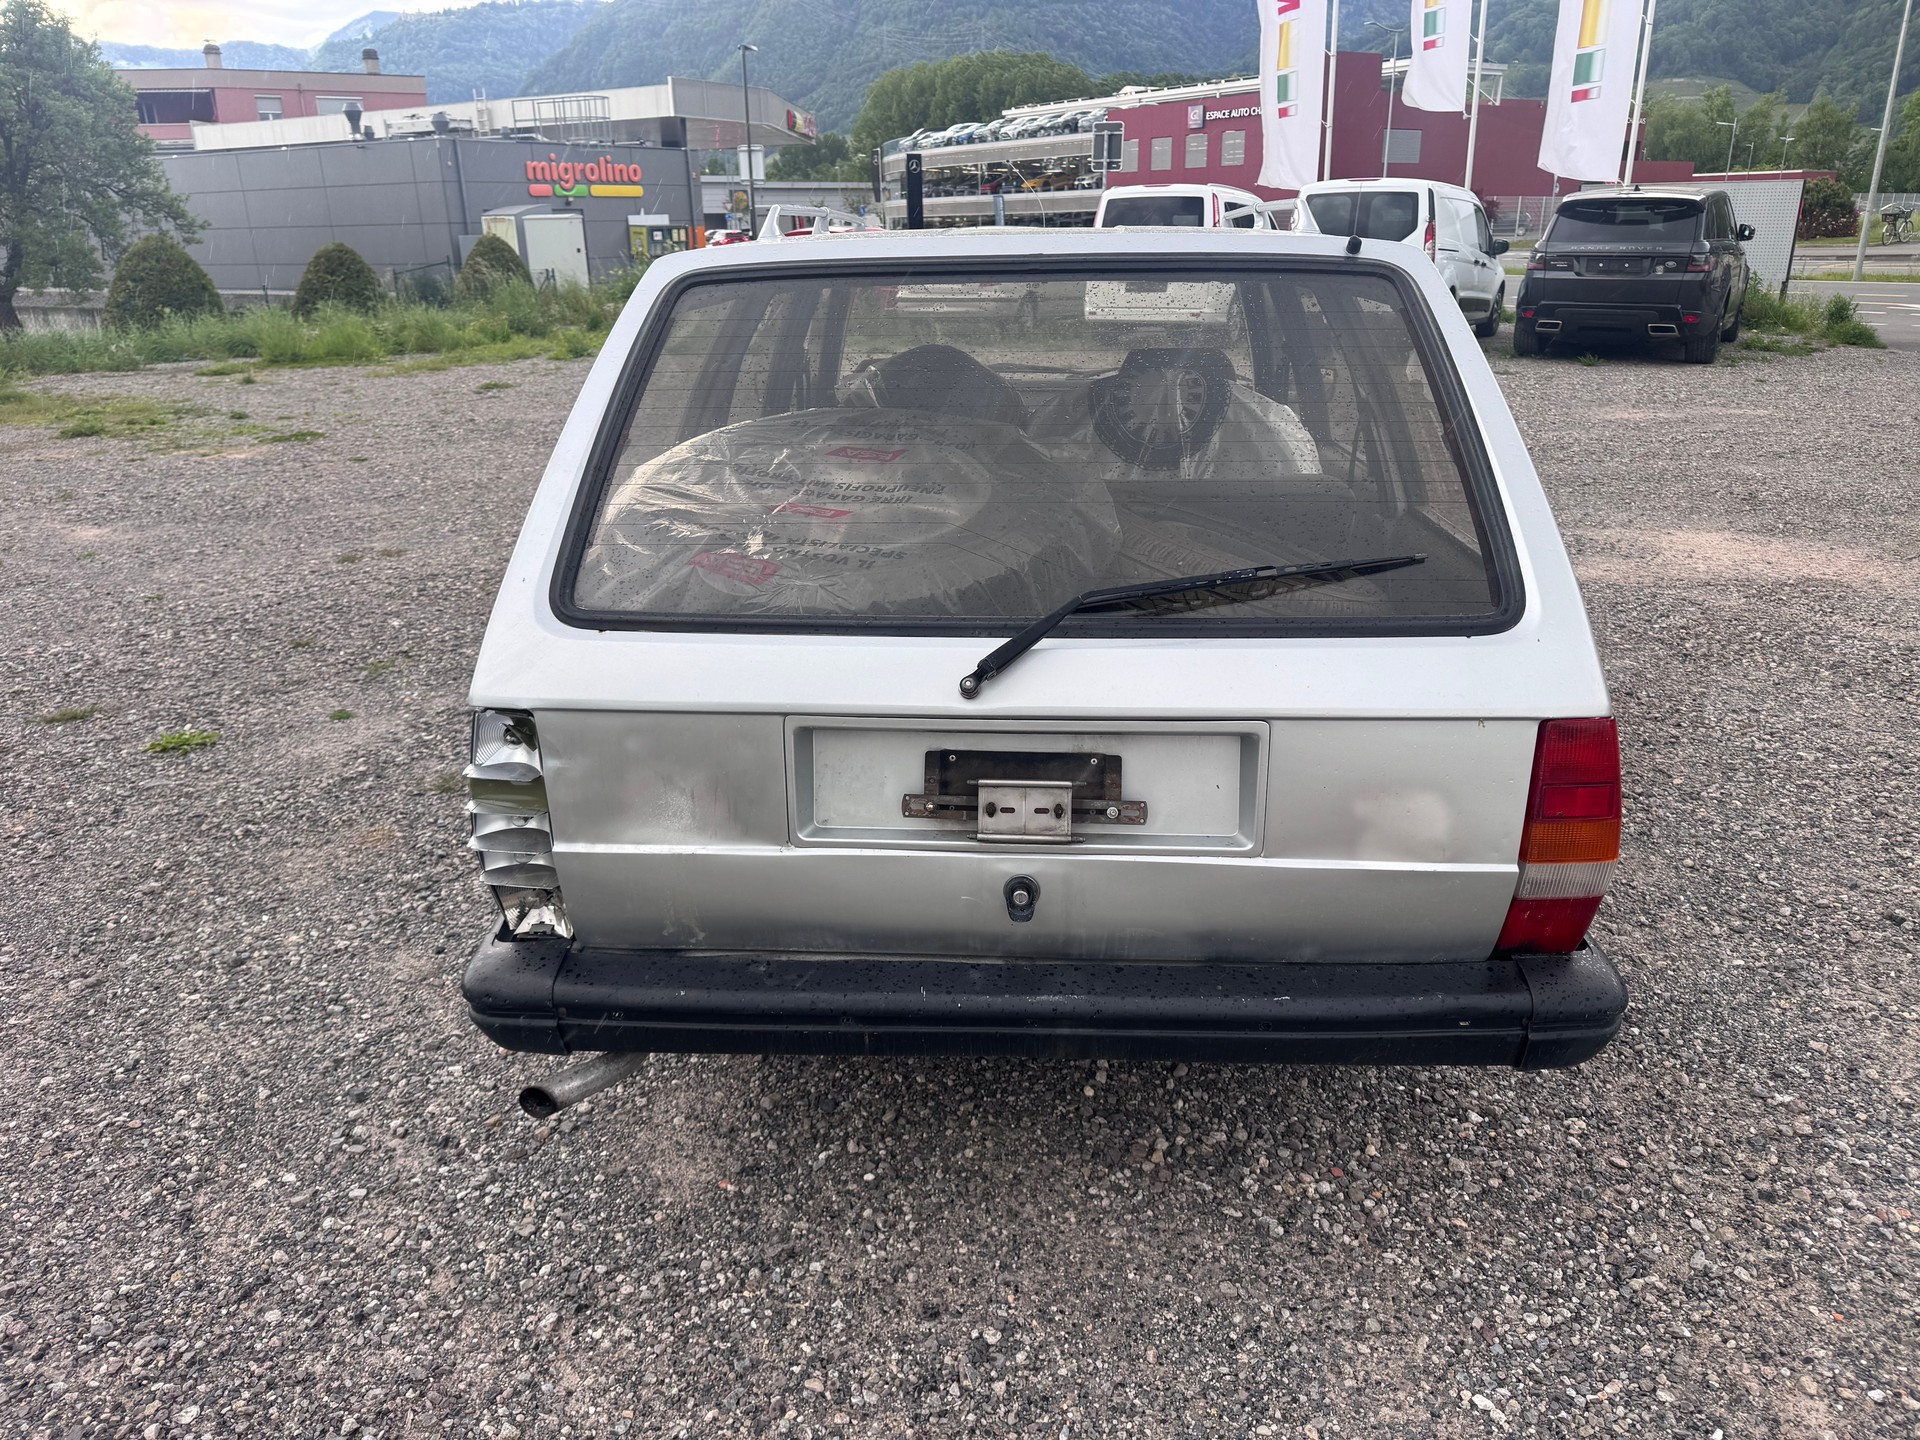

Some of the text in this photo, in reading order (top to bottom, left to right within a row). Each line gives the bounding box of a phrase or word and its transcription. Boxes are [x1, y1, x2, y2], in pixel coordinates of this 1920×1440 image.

[1206, 110, 1230, 120] ESPACE
[1231, 107, 1250, 117] AUTO
[526, 153, 642, 191] migrolino
[871, 494, 914, 504] IHRE
[773, 546, 876, 571] IL VOSTRO
